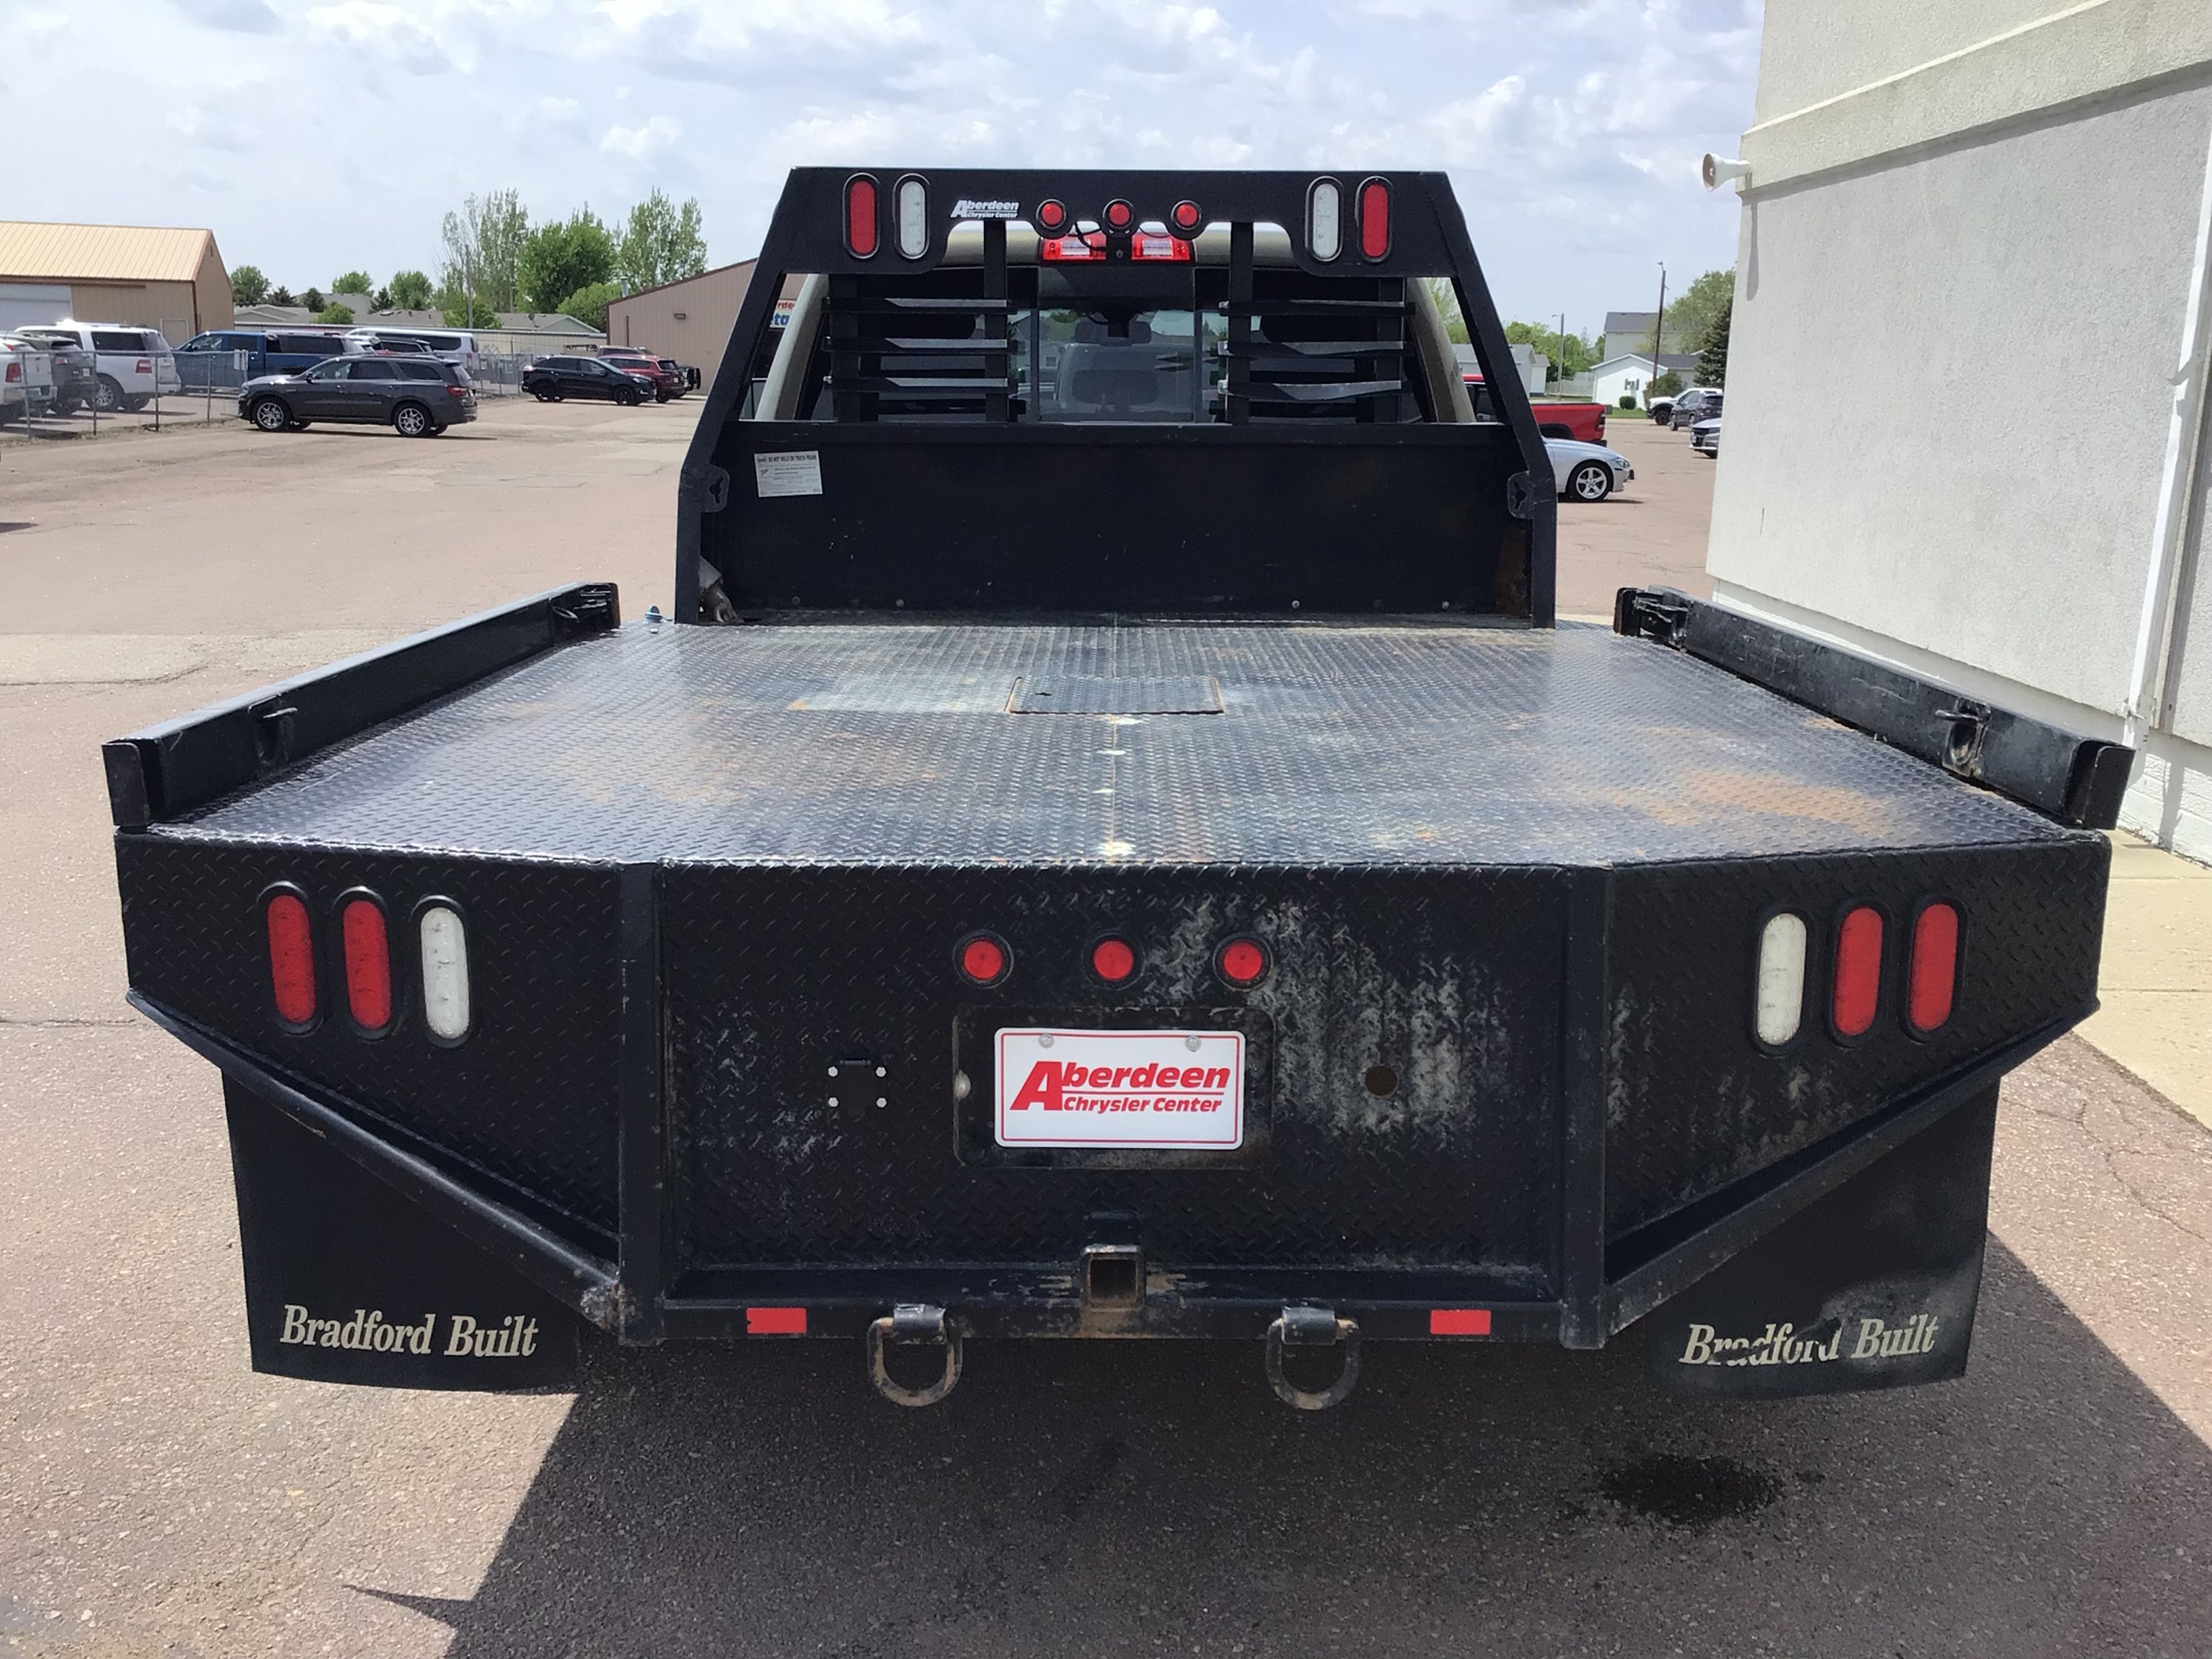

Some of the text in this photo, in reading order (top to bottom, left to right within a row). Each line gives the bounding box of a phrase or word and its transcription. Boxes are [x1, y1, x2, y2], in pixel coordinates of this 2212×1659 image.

[950, 200, 1019, 218] Aberdeen
[1010, 1061, 1231, 1111] Aberdeen
[1064, 1097, 1222, 1113] Chrysler Center
[279, 1304, 539, 1357] Bradford Built
[1851, 1313, 1939, 1359] Built
